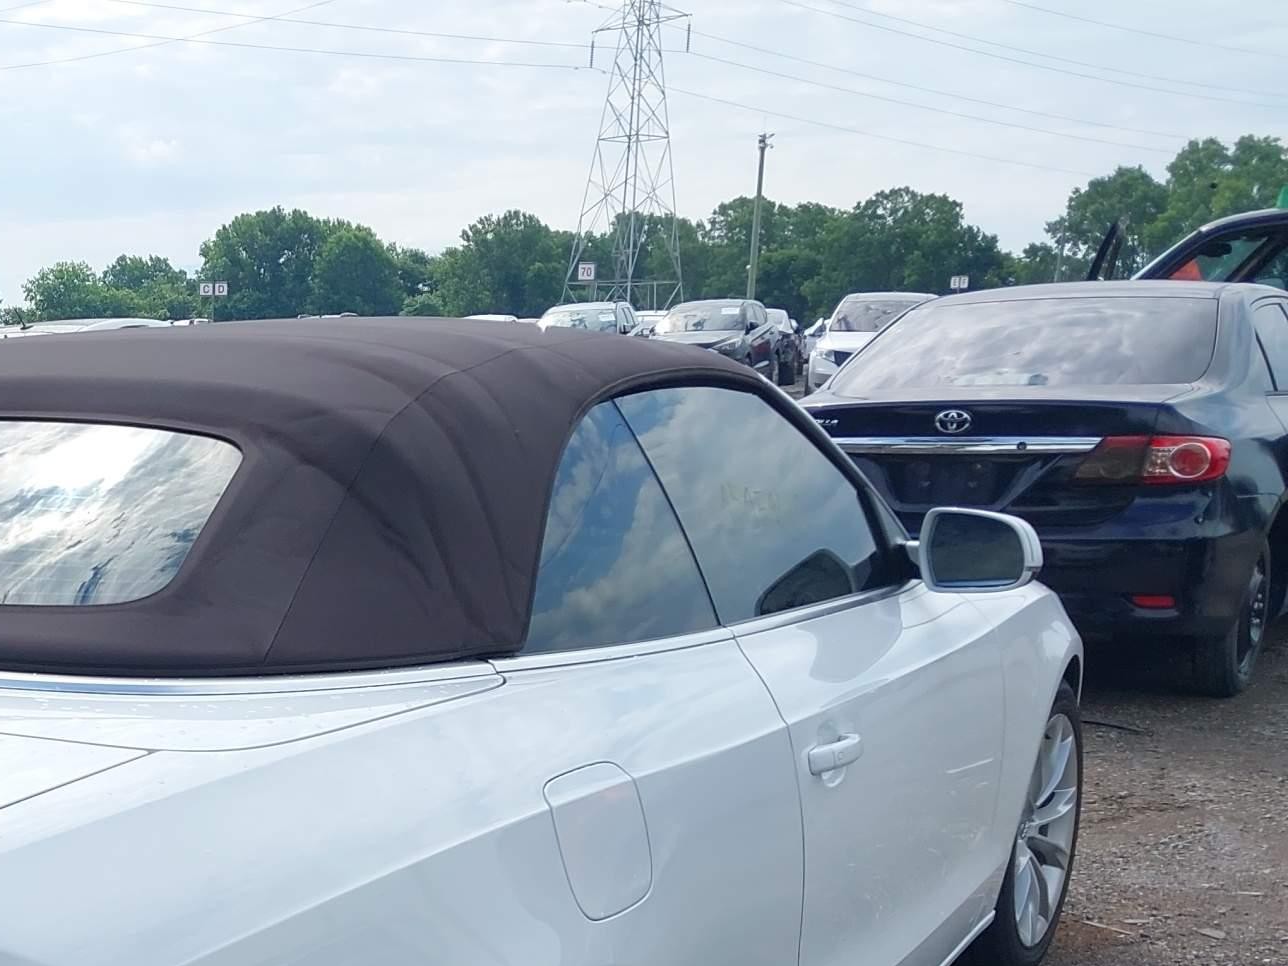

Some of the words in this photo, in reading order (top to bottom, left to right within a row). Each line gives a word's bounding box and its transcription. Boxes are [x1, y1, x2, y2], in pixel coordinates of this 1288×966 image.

[580, 266, 593, 277] 70
[202, 284, 210, 294] C
[217, 284, 225, 294] D
